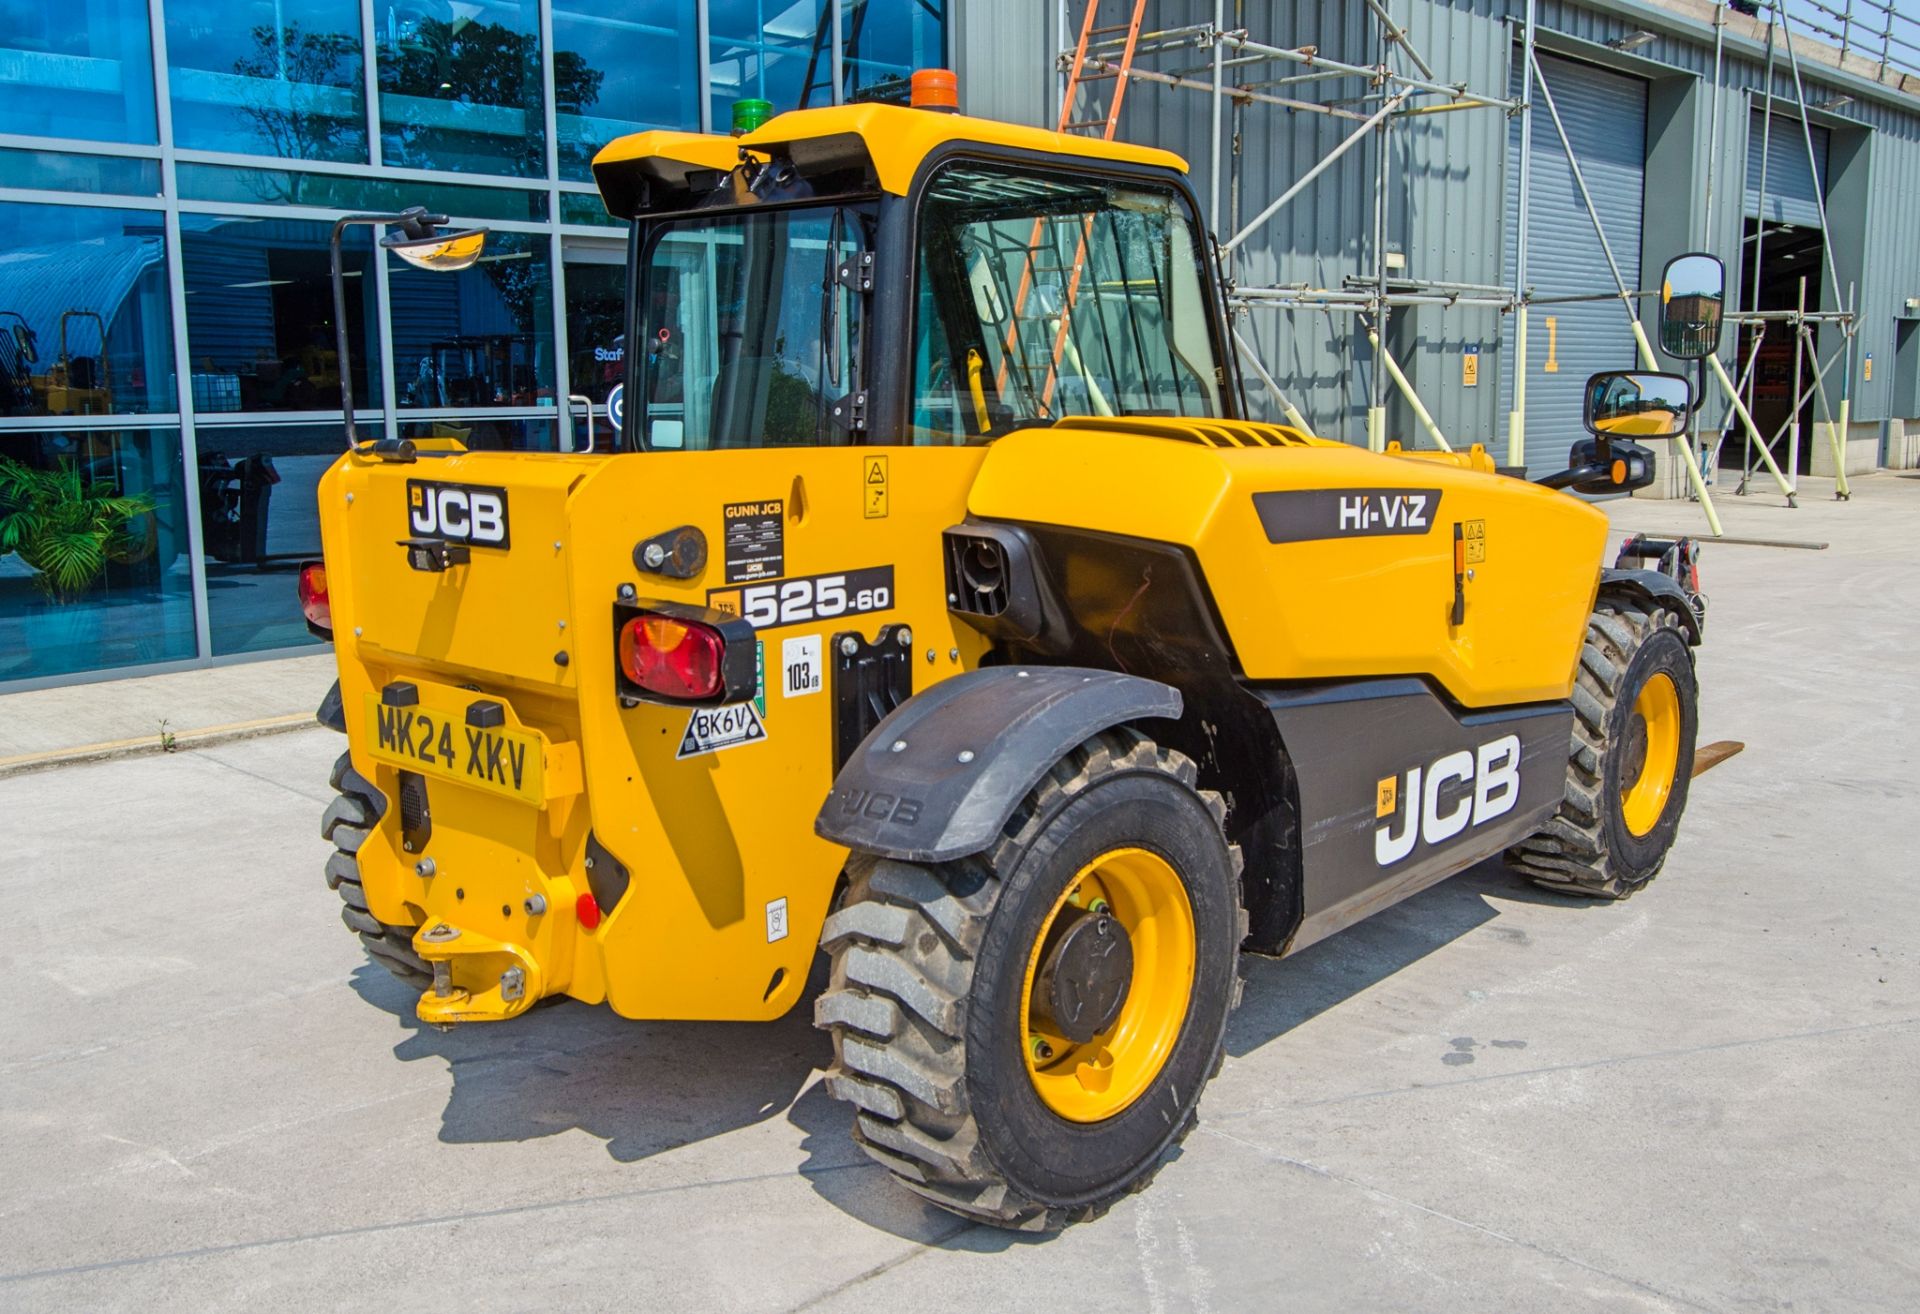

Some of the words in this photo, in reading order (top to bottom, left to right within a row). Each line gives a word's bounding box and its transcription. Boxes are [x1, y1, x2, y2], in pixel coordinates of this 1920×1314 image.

[1544, 316, 1558, 372] 1
[411, 487, 504, 542] JCB
[725, 505, 759, 518] GUNN
[761, 503, 781, 515] JCB
[787, 662, 810, 692] 103
[697, 707, 745, 739] BK6V
[377, 703, 456, 769] MK24
[465, 727, 525, 791] XKV
[842, 788, 925, 826] JCB
[1375, 734, 1520, 866] JCB
